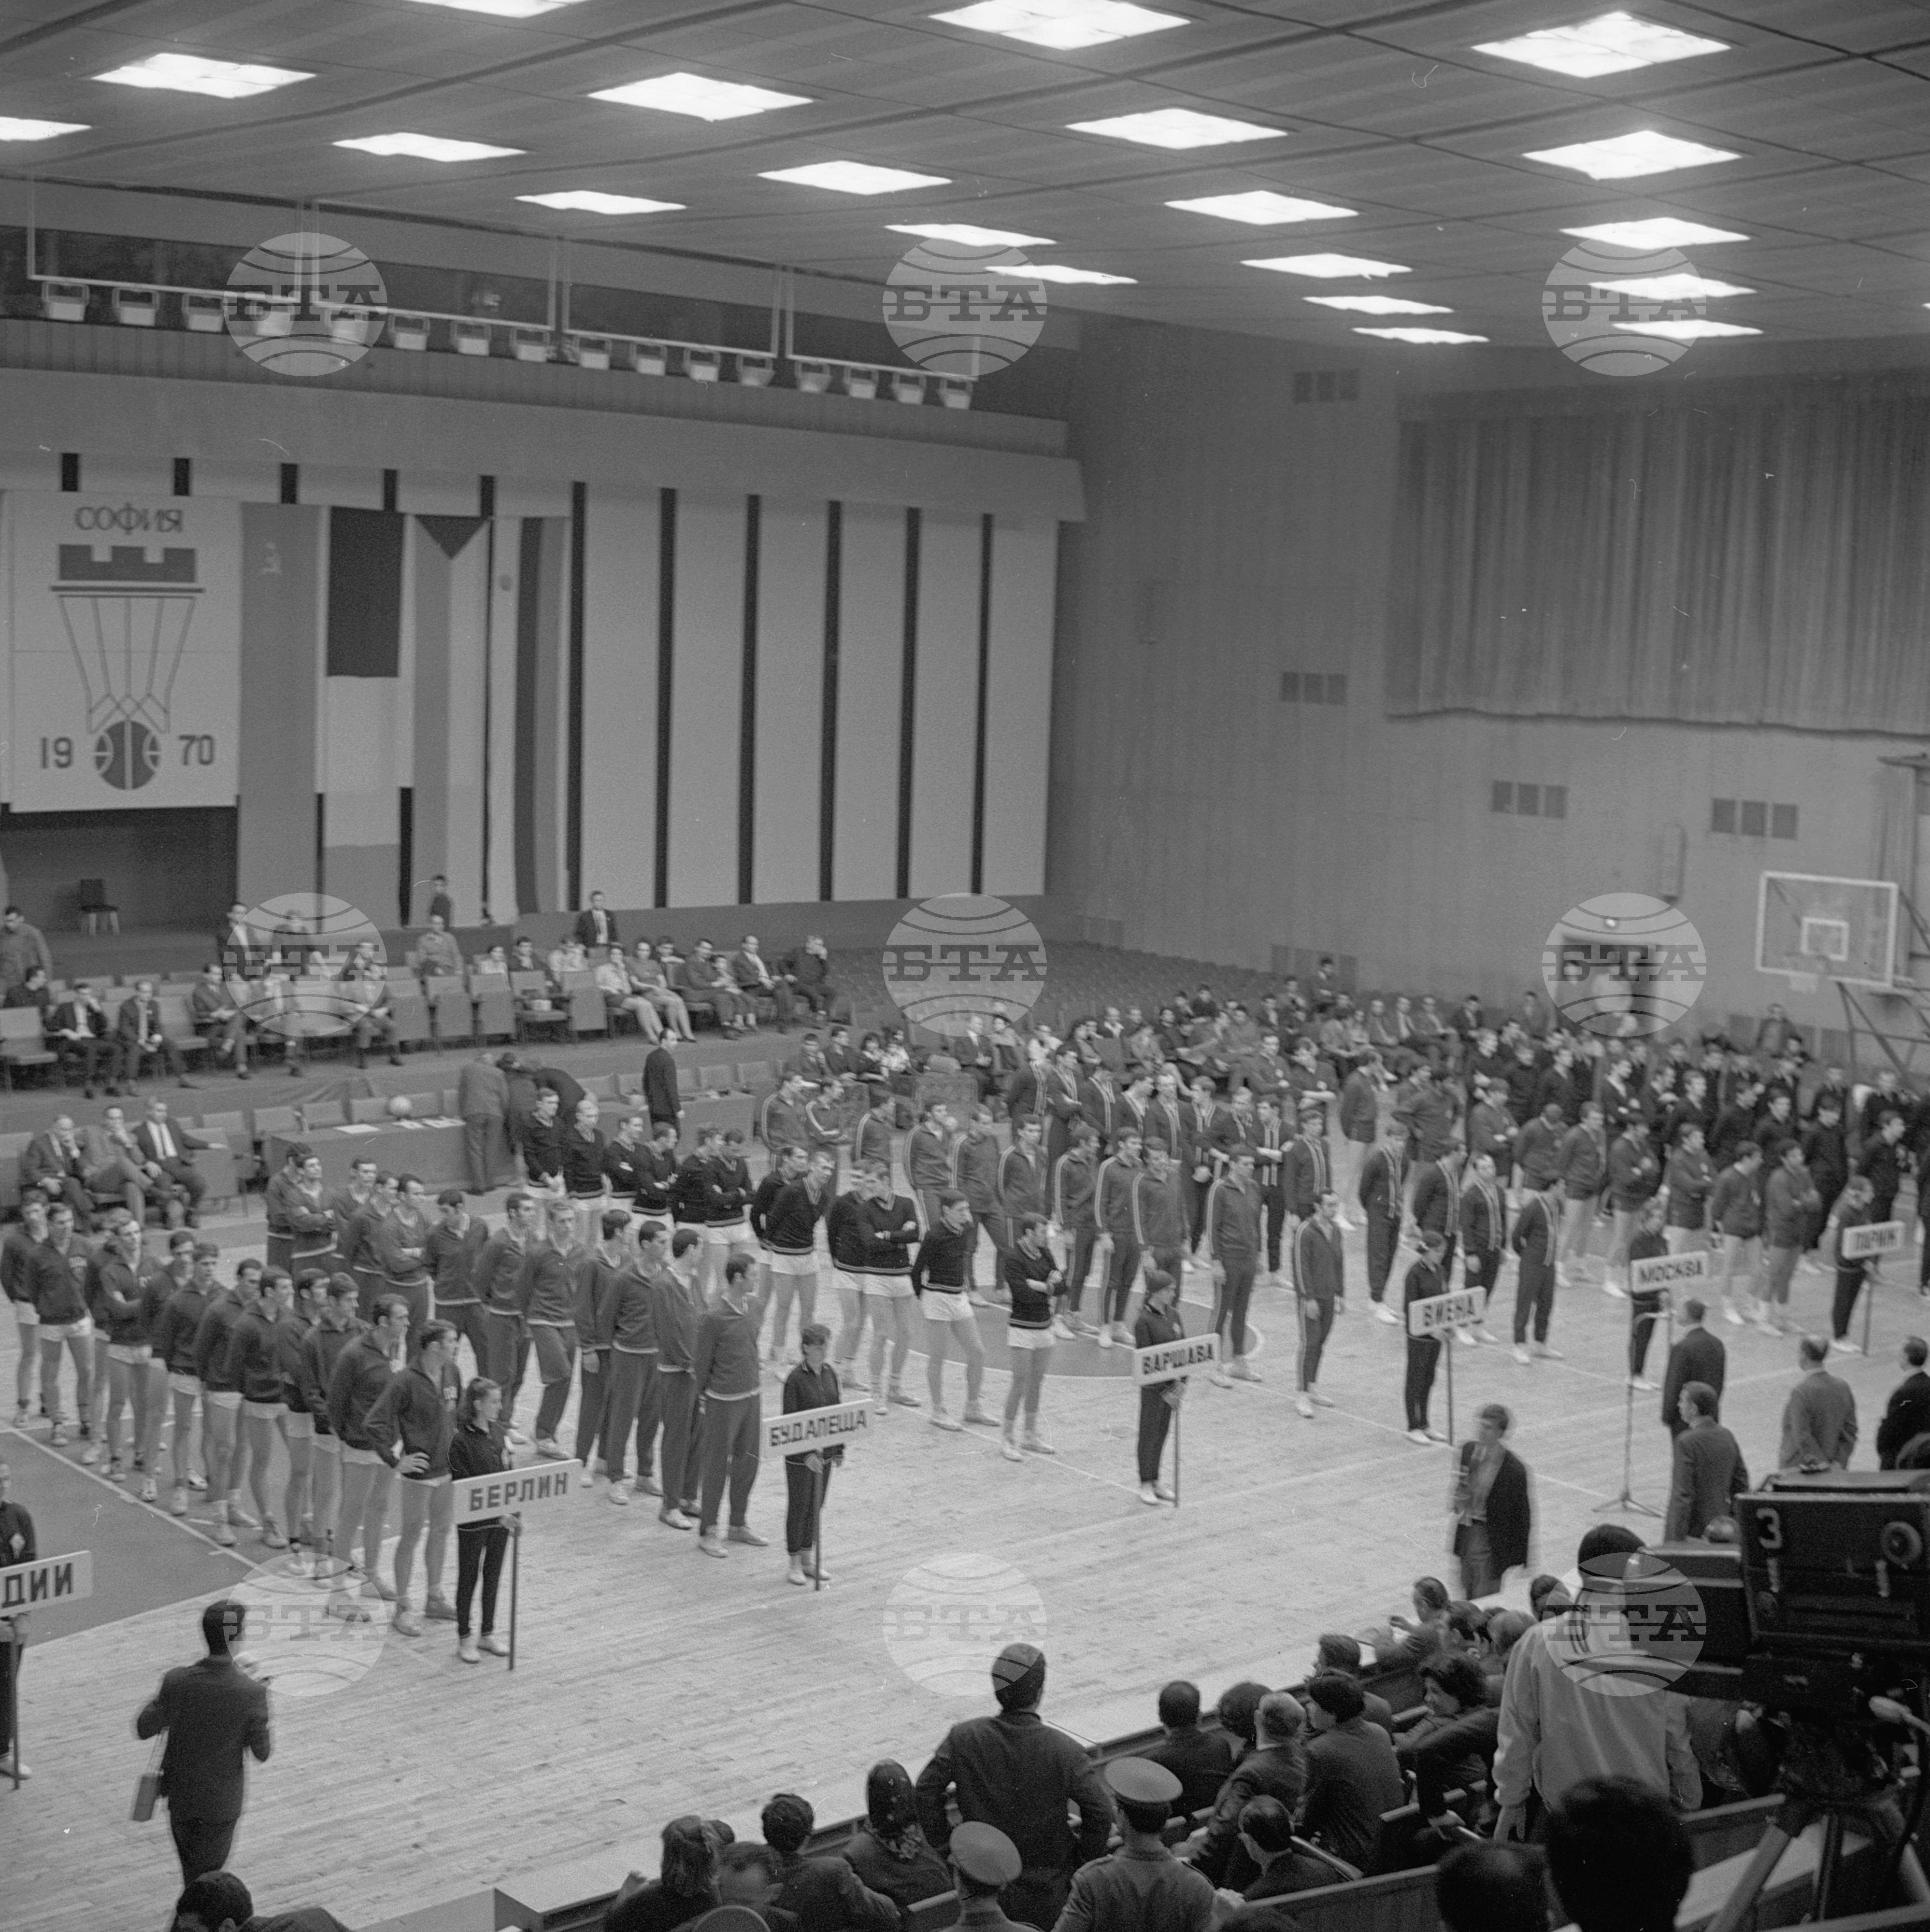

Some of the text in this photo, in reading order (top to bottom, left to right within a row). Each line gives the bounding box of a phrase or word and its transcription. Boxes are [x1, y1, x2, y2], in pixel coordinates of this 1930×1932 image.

[74, 502, 184, 536] СОФИЯ
[41, 734, 214, 769] 19 70
[1639, 1259, 1702, 1283] МОСКВА
[1424, 1294, 1474, 1326] ВИЕНА
[1143, 1343, 1214, 1375] ВАРШАВА
[470, 1471, 568, 1511] БЕРЛИН
[1756, 1506, 1783, 1549] 3
